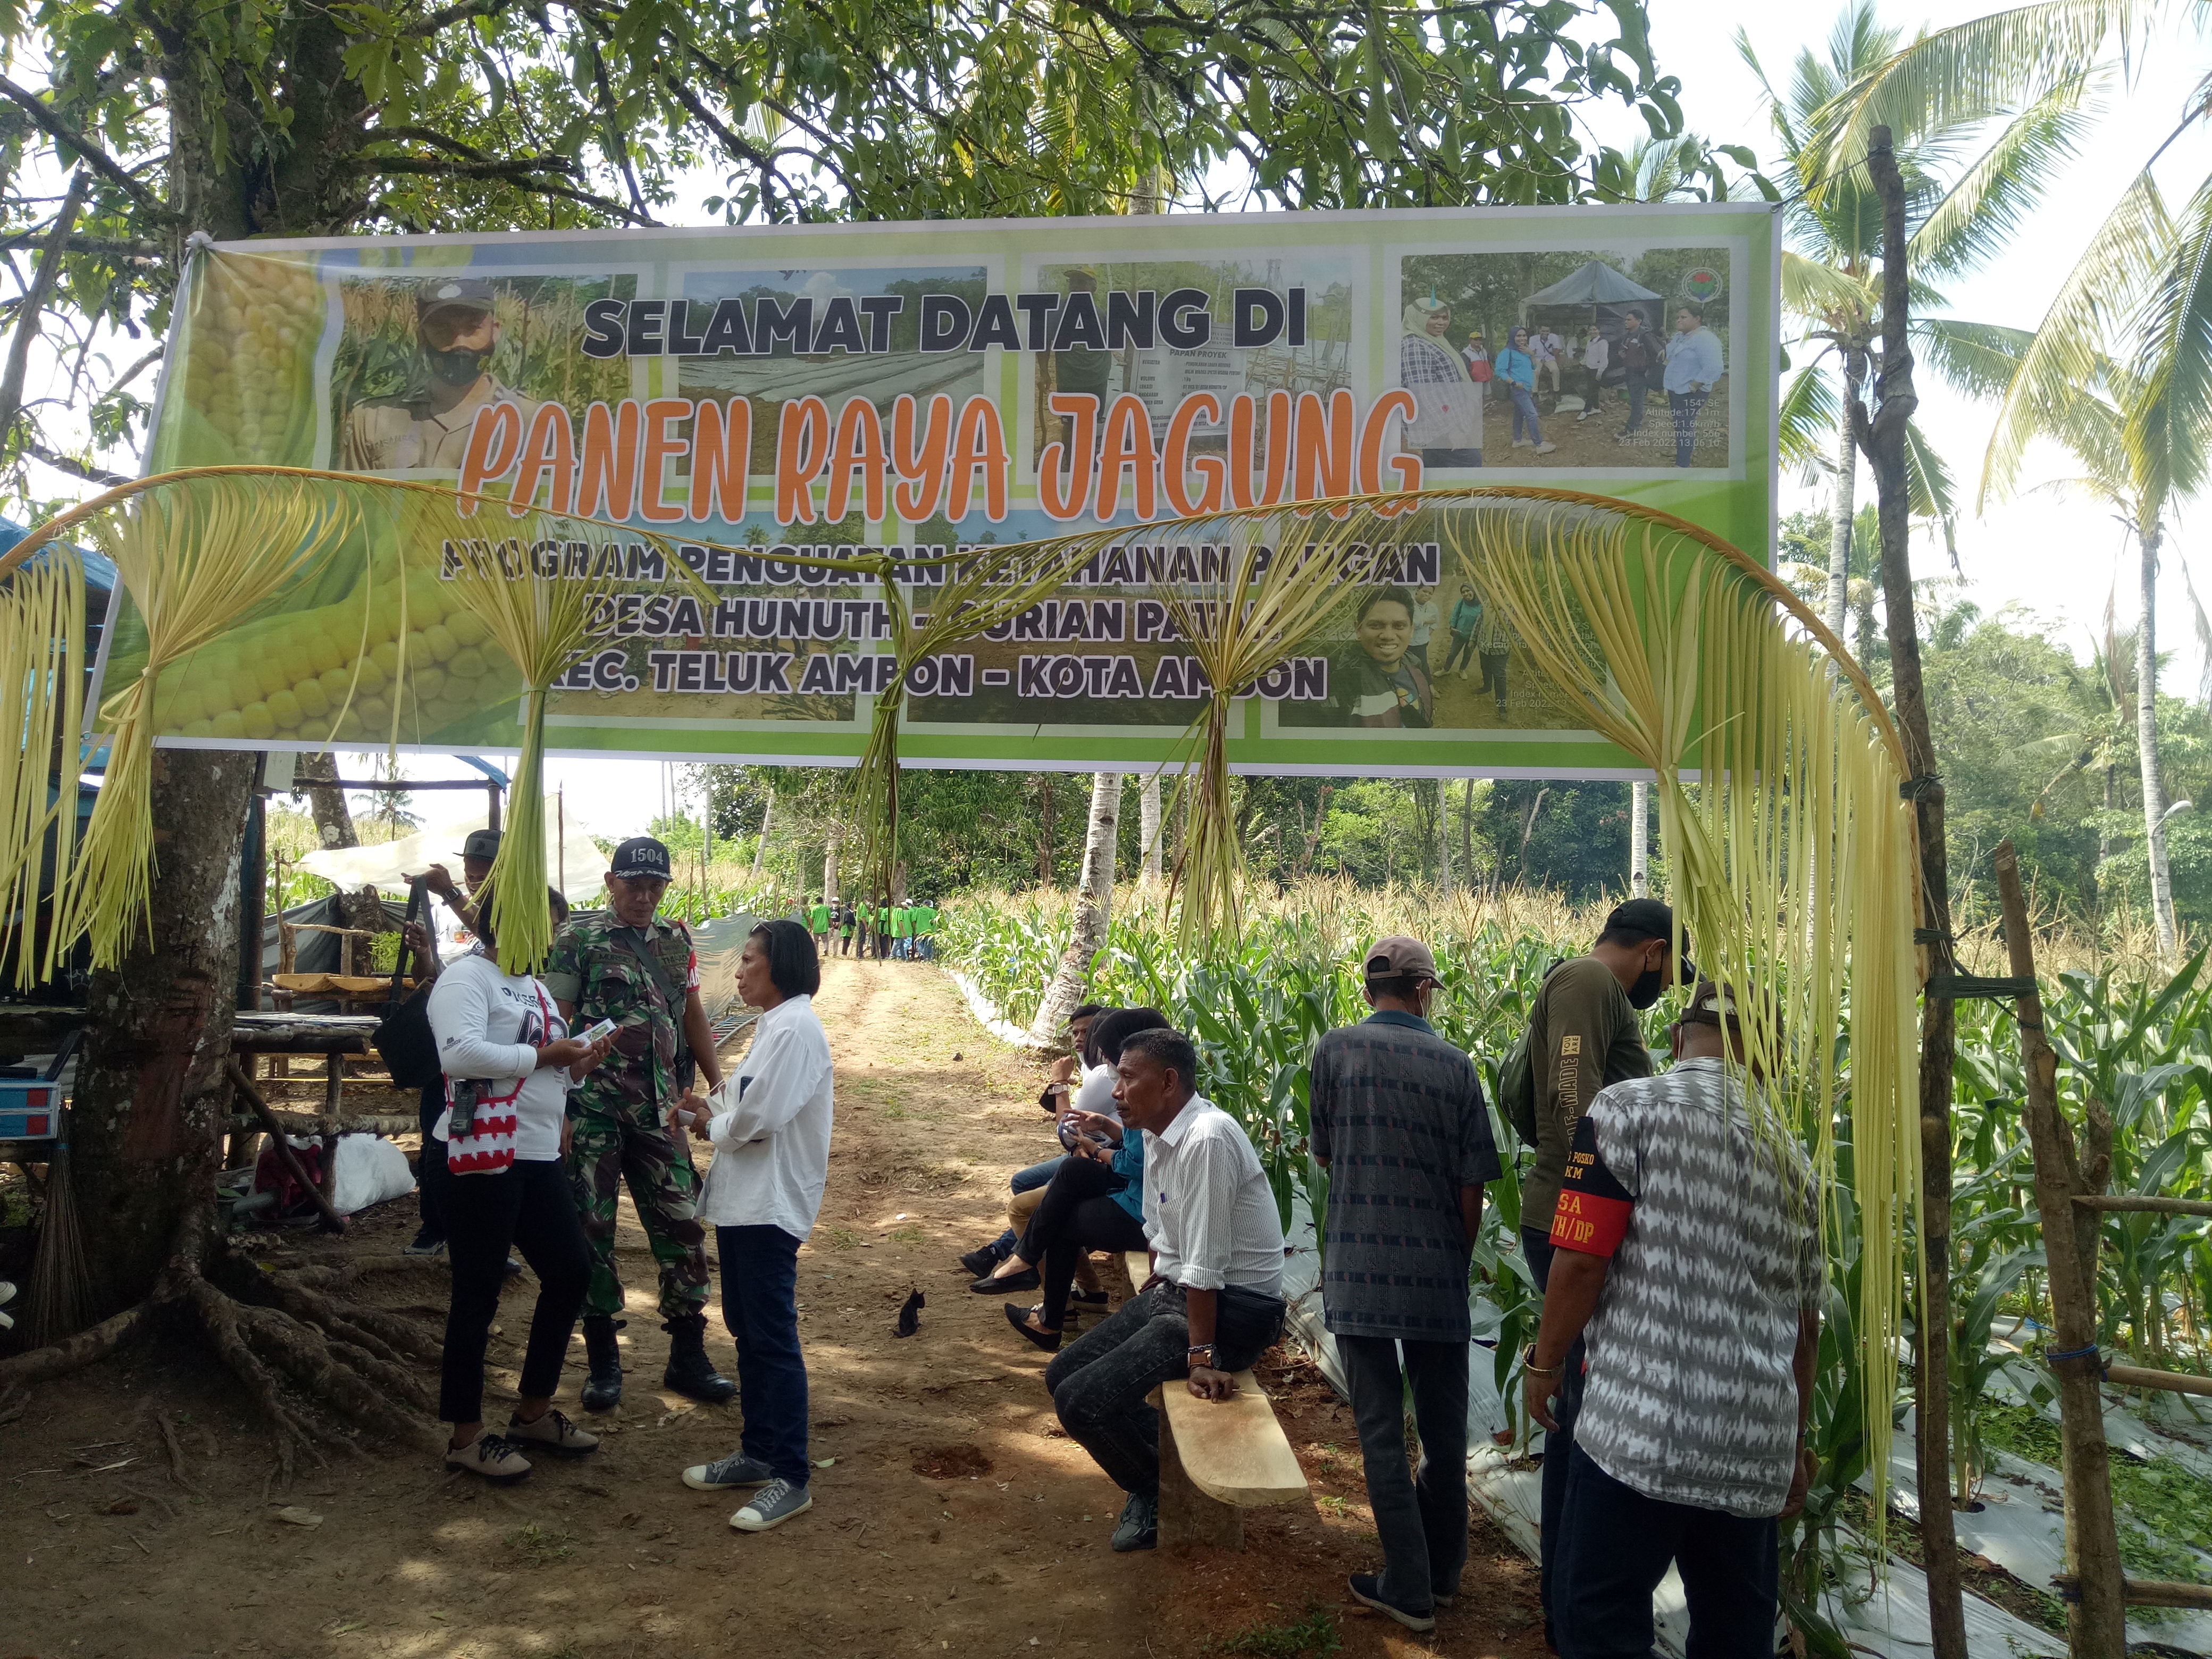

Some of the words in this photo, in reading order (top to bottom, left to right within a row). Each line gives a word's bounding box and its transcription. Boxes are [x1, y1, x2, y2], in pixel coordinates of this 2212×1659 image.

[581, 296, 903, 359] SELAMAT
[920, 288, 1211, 353] DATANG
[1233, 287, 1306, 349] DI
[457, 396, 752, 525] PANEN
[774, 393, 1011, 526] RAYA
[1037, 388, 1424, 523] JAGUNG
[440, 537, 667, 583] PROGRAM
[677, 543, 946, 586] PENGUATAN
[1244, 542, 1440, 585] PNGAN
[582, 593, 705, 637] DESA
[713, 597, 897, 640] HUNUTH
[1134, 599, 1282, 642] PAT
[648, 651, 794, 694] TELUK
[798, 653, 974, 697] AMBON
[1019, 654, 1144, 698] KOTA
[631, 848, 664, 865] 1504
[1558, 1058, 1579, 1146] F-MADE
[1572, 1152, 1595, 1165] POSKO
